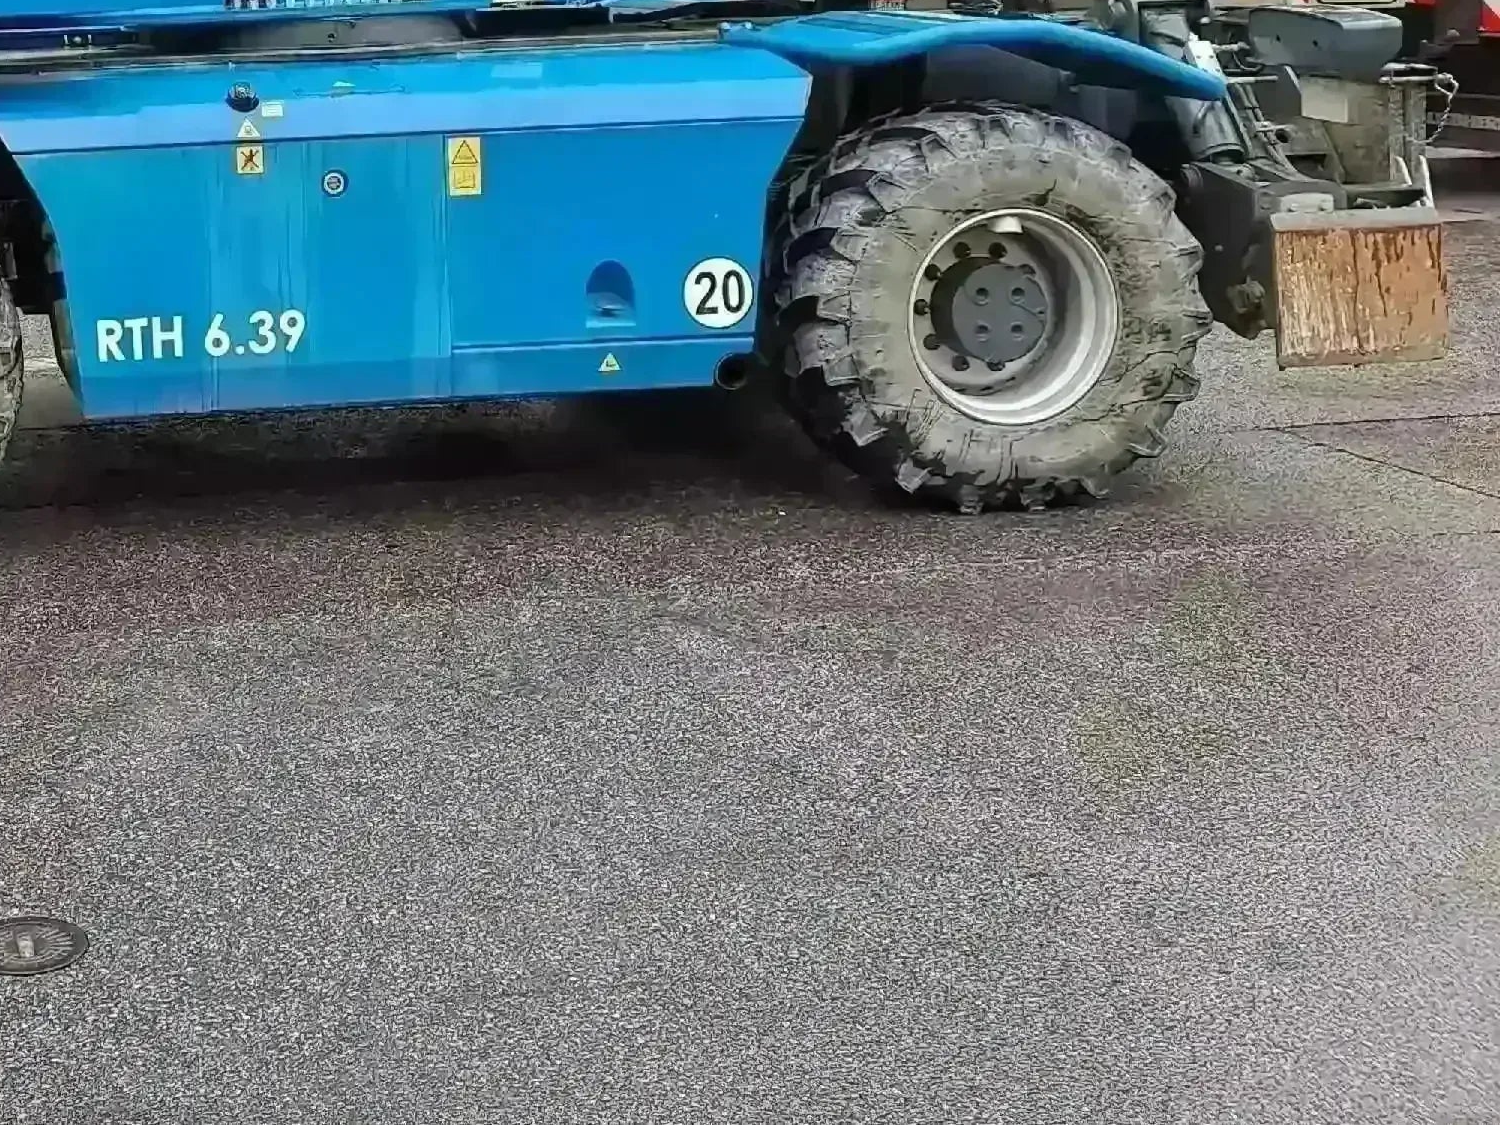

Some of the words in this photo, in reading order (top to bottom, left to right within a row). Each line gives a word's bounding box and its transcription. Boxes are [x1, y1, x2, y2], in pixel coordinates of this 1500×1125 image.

[693, 269, 746, 317] 20
[96, 316, 184, 362] RTH
[204, 309, 306, 357] 6.39
